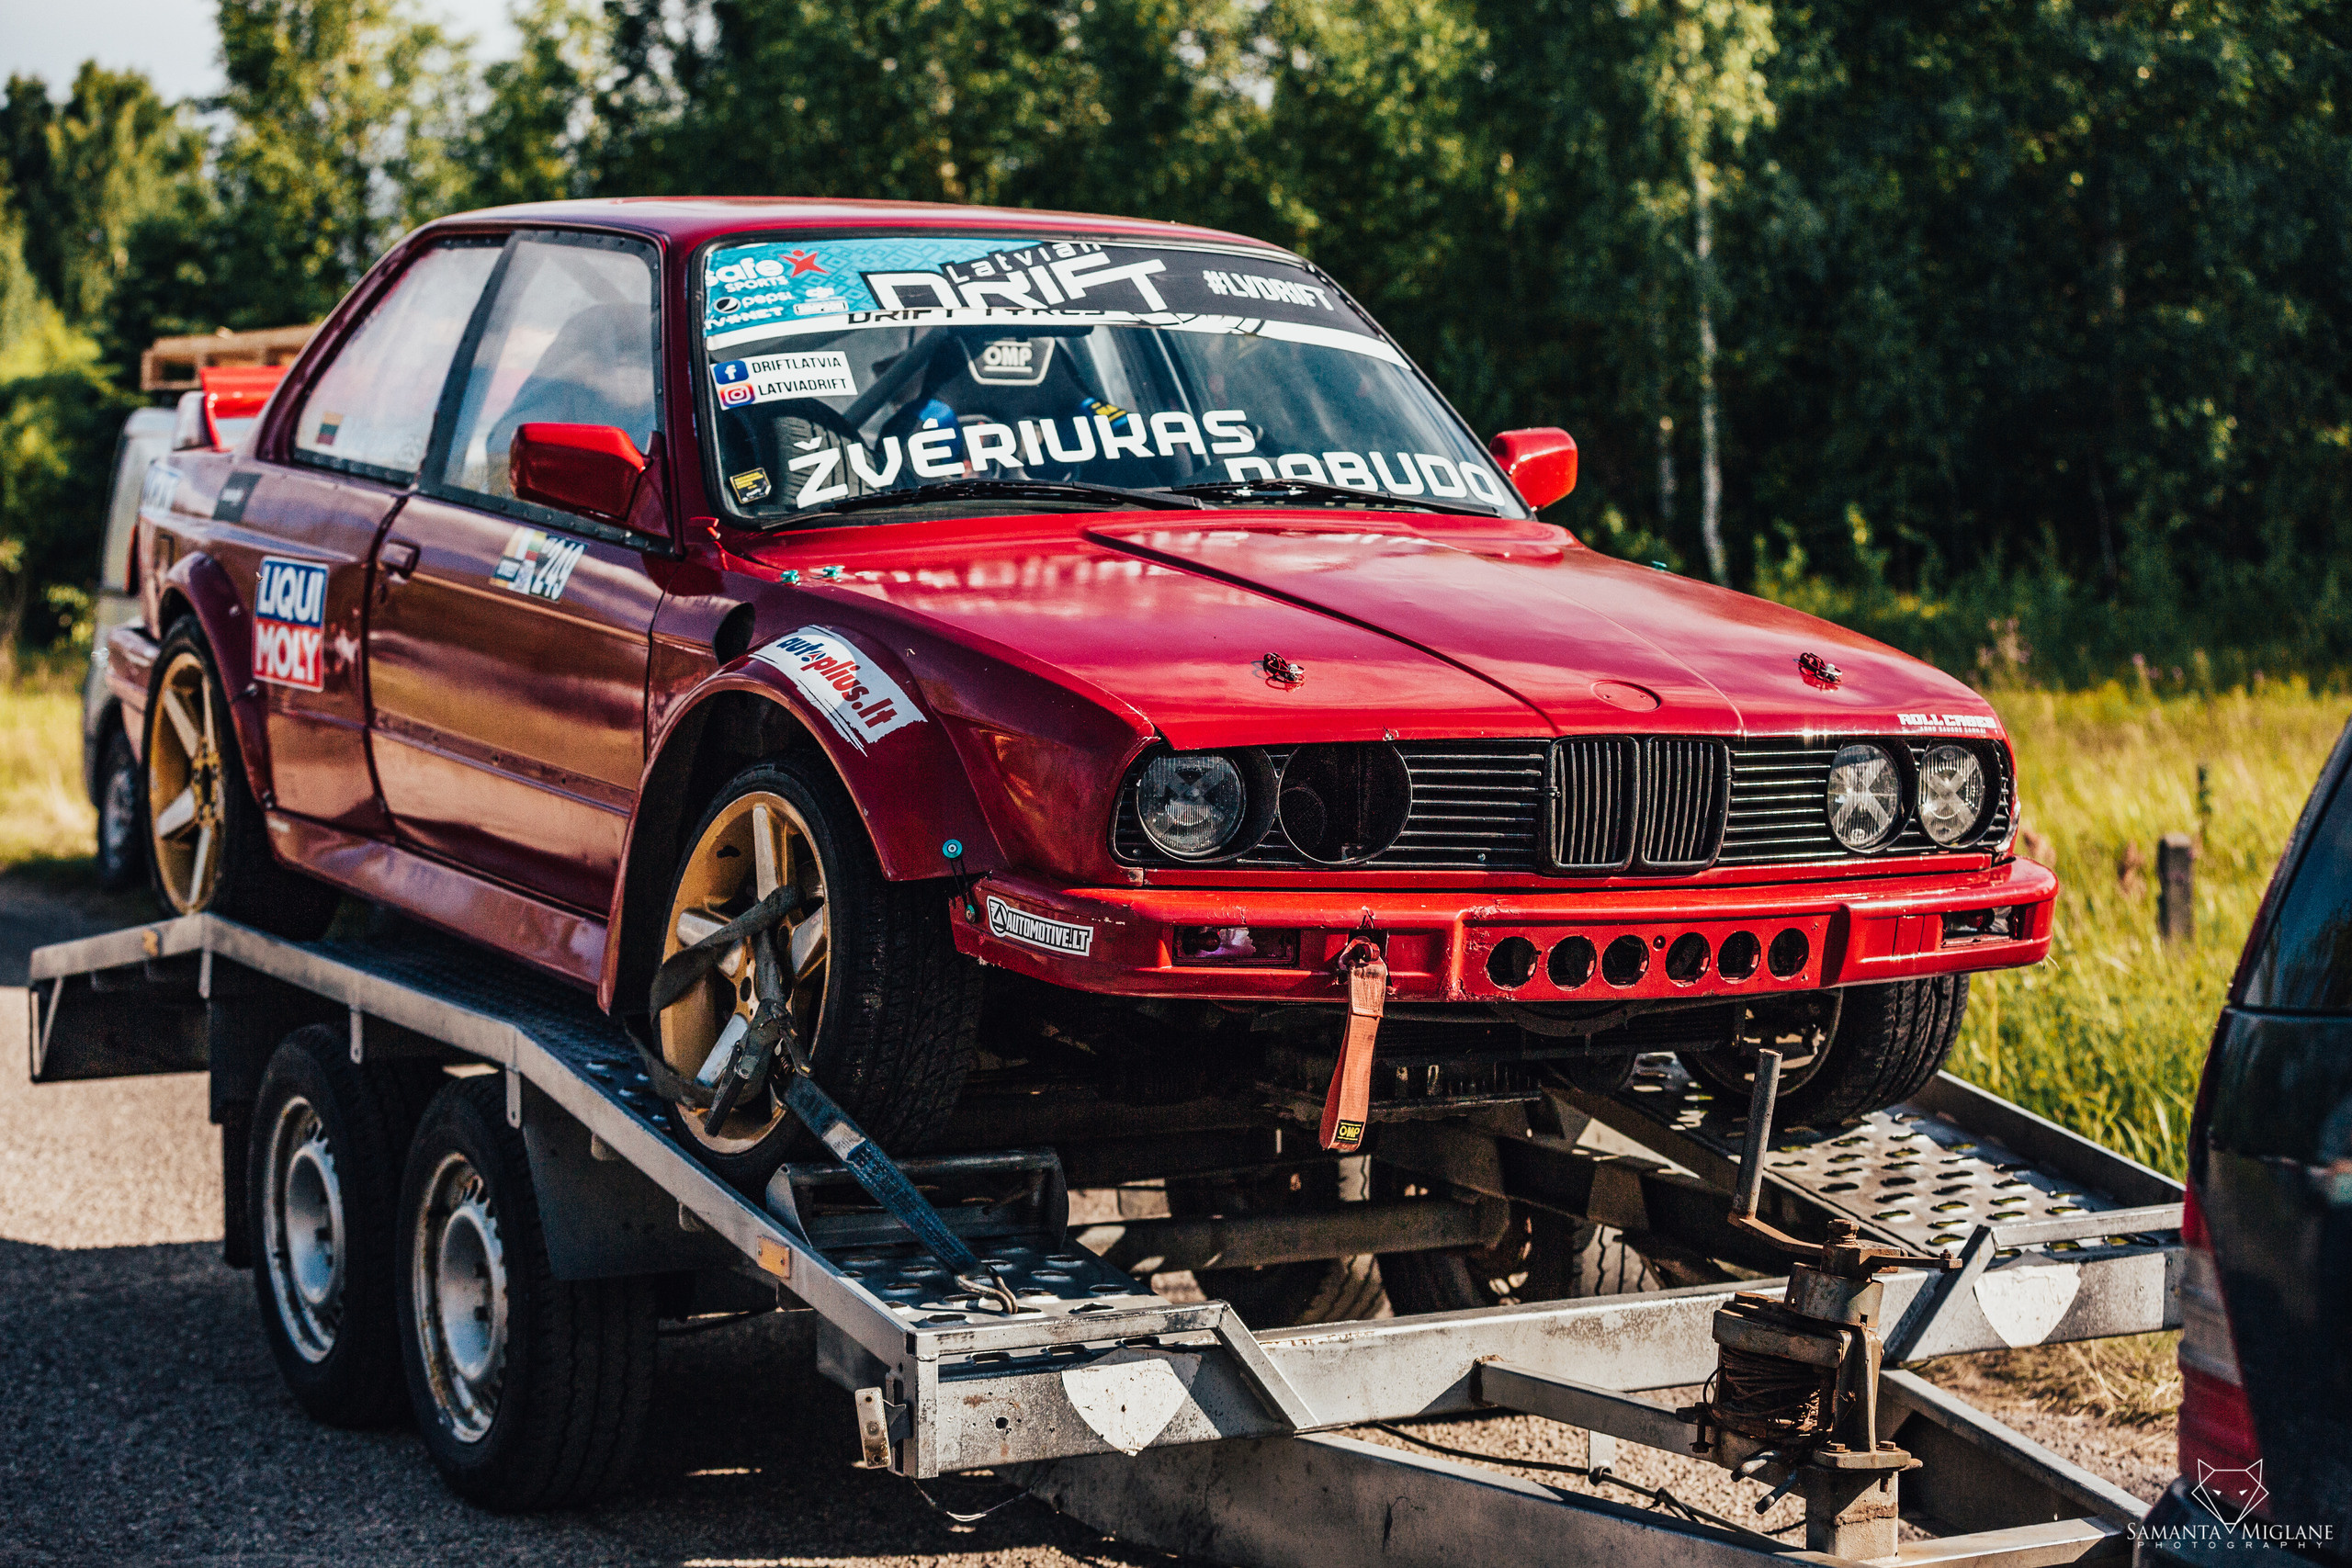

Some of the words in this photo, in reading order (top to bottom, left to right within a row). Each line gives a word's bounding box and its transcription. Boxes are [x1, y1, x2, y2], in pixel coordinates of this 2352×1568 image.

[724, 276, 789, 293] SPORTS
[741, 291, 793, 308] pepsi
[866, 251, 1168, 311] DRIFT
[1203, 270, 1334, 311] #LVDRIFT
[752, 357, 842, 373] DRIFTLATVIA
[983, 346, 1033, 367] OMP
[758, 378, 847, 396] LATVIADRIFT
[788, 410, 1256, 509] ŽVĖRIUKAS
[257, 564, 324, 624] LIQUI
[254, 623, 321, 682] MOLY
[776, 636, 898, 728] autoplius.lt
[1006, 911, 1088, 950] AUTOMOTIVE.LT
[1339, 1125, 1360, 1137] OMP
